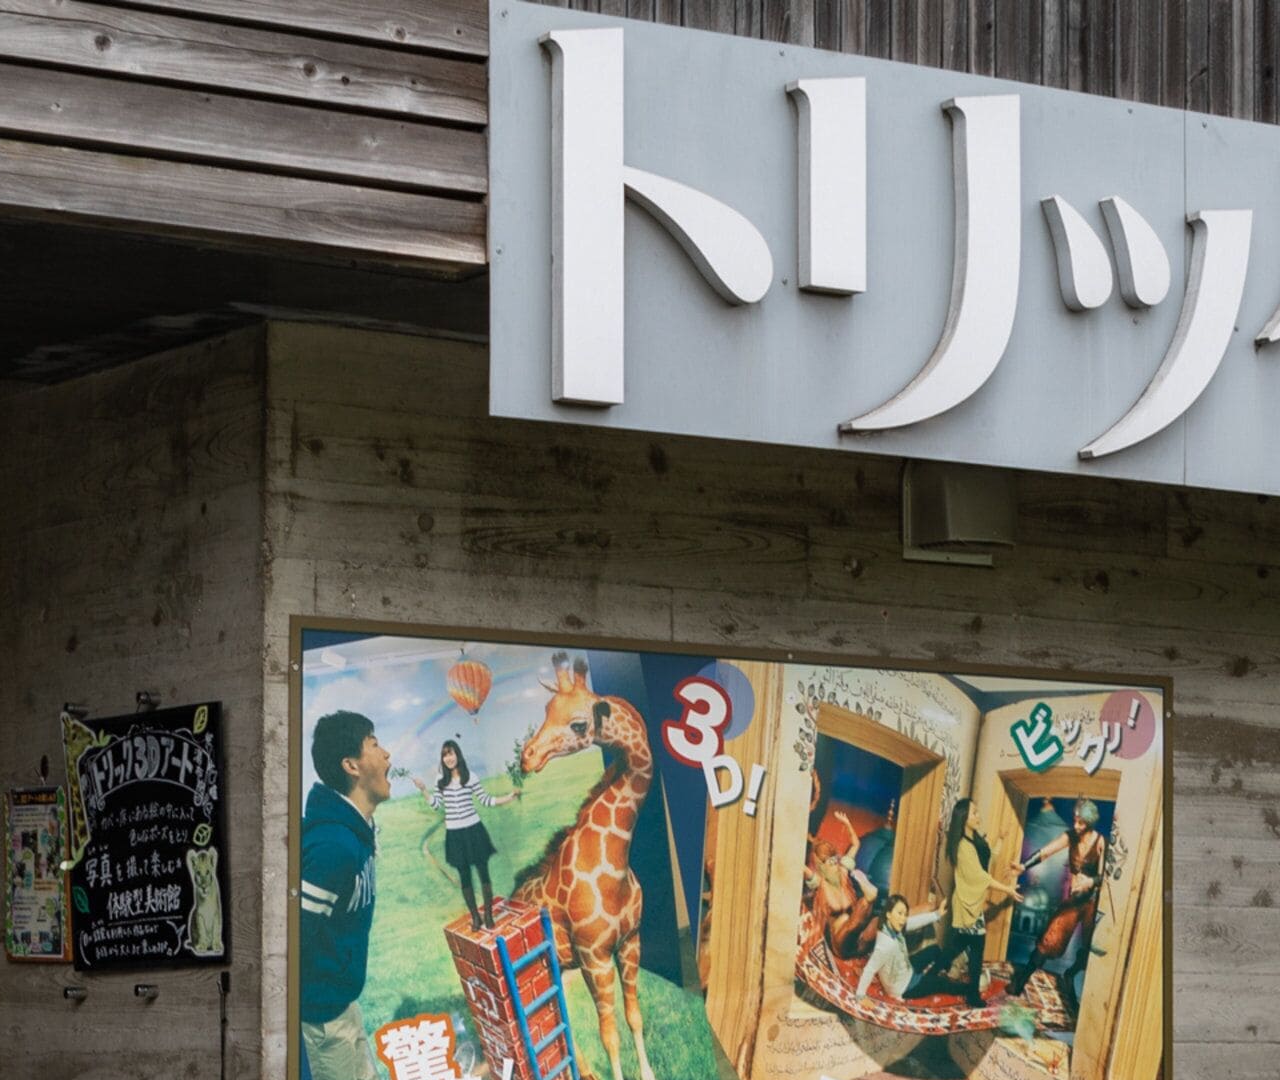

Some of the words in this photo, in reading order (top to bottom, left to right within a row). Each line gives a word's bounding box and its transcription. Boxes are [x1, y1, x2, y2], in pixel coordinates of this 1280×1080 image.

[94, 735, 194, 796] トリック3Dアート
[663, 678, 765, 814] 3D!
[1012, 698, 1140, 776] ビックリ!
